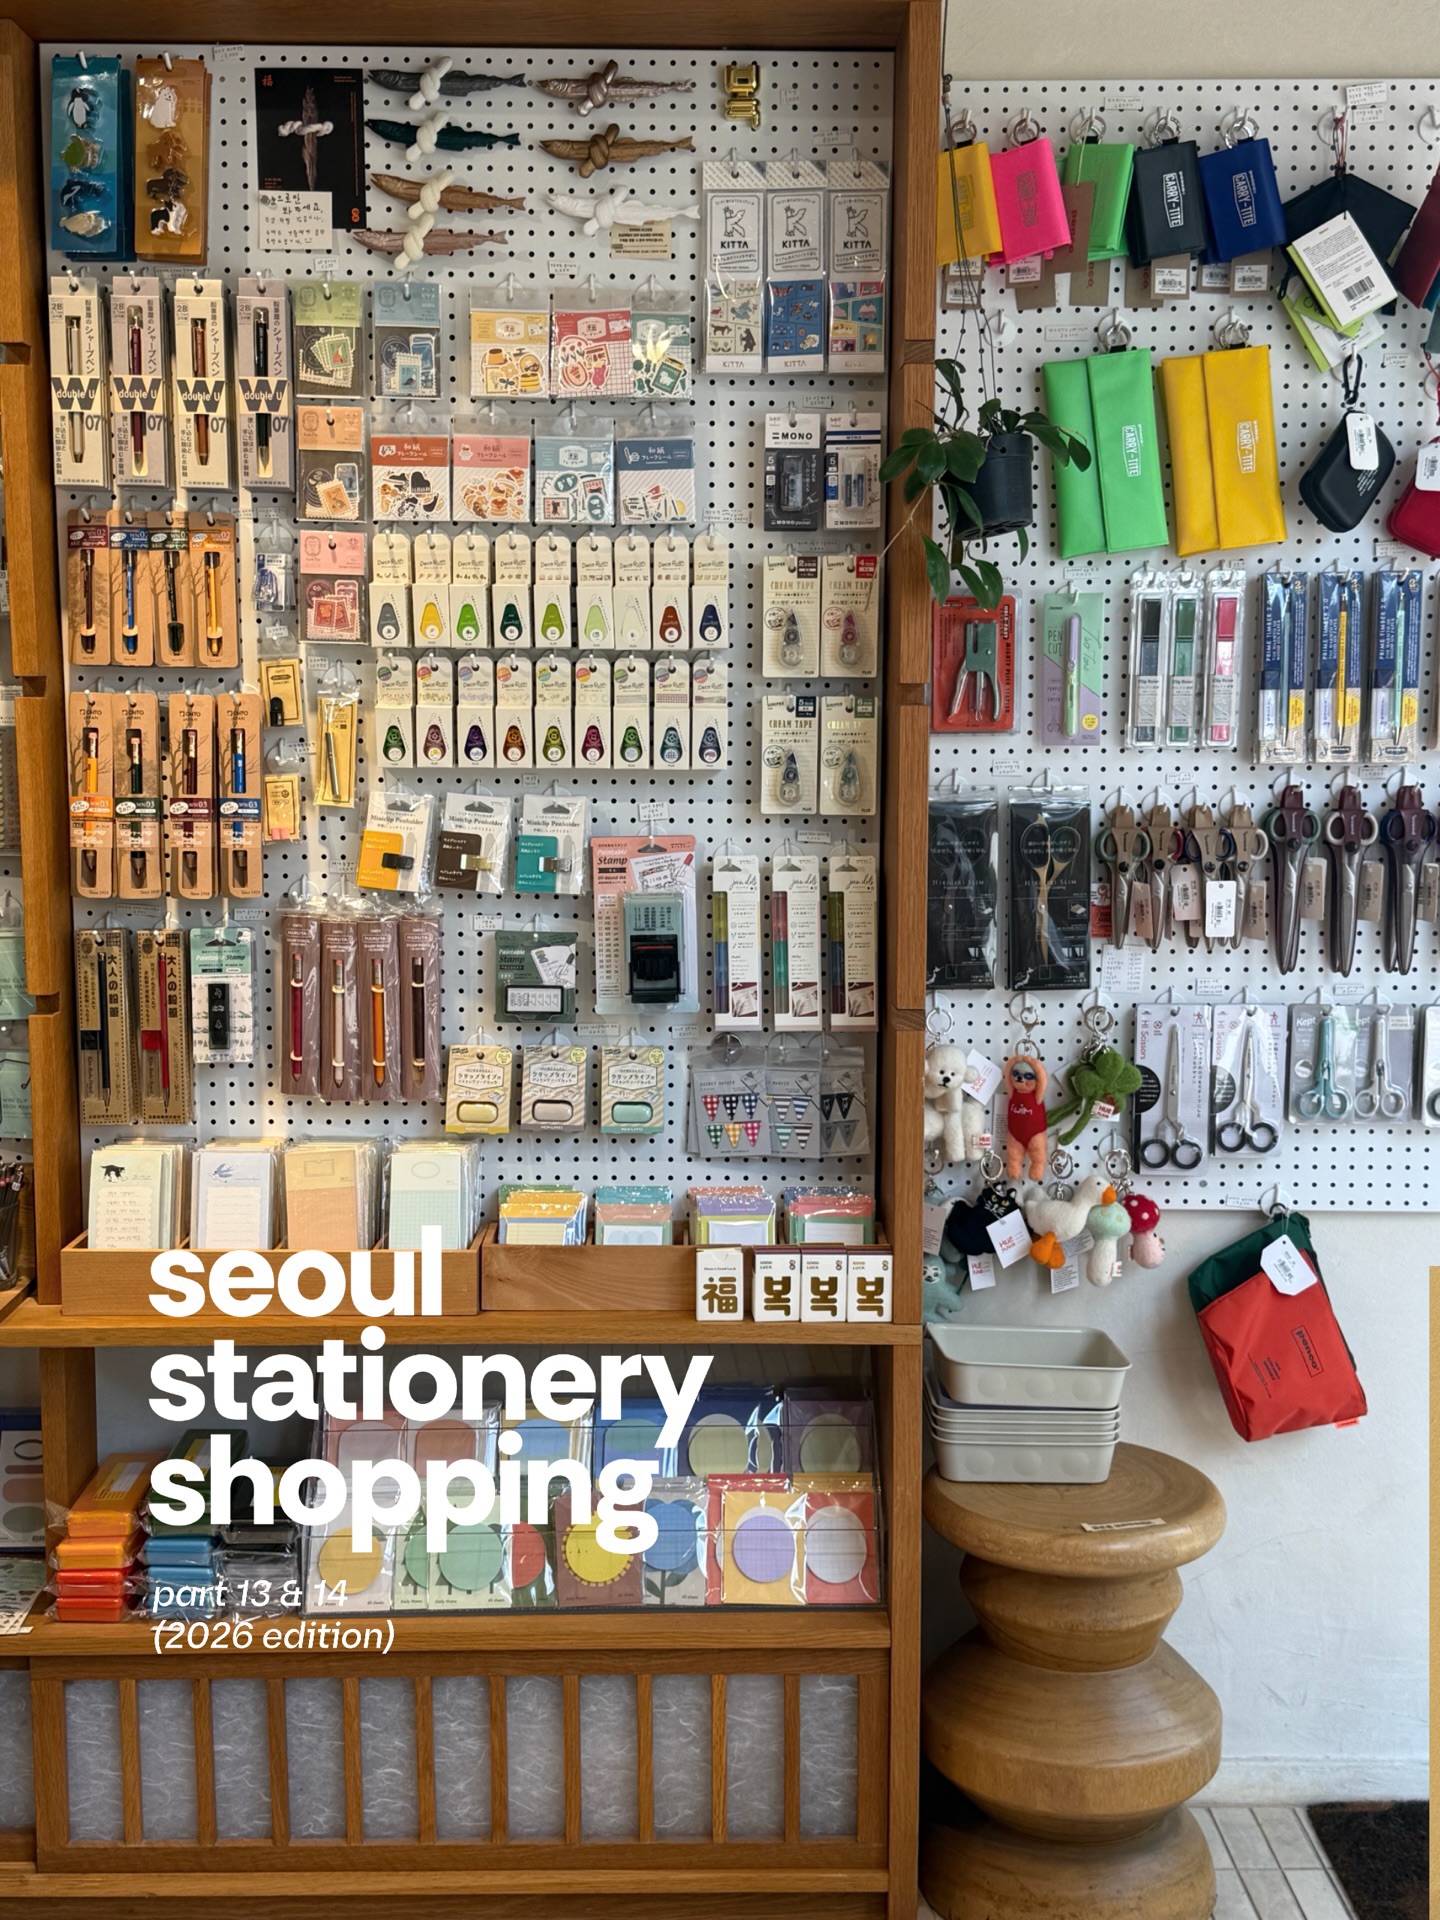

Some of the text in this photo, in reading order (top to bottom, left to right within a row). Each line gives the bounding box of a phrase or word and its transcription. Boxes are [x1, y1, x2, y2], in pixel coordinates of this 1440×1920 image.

[1165, 173, 1181, 226] CARRY-TITE
[1235, 173, 1253, 226] CARRY-TITE
[720, 240, 749, 249] KITTA
[782, 239, 810, 248] KITTA
[843, 240, 872, 249] KITTA
[56, 389, 96, 399] double U
[118, 389, 157, 400] double U
[182, 391, 221, 401] double U
[244, 391, 283, 401] double U
[85, 415, 101, 431] 07
[147, 415, 163, 431] 07
[210, 417, 226, 434] 07
[272, 416, 289, 433] 07
[781, 432, 813, 440] MONO
[1125, 425, 1139, 476] CARRY-TITE
[1240, 422, 1253, 472] CARRY-TITE
[770, 581, 815, 590] CREAM TAPE
[829, 581, 852, 590] CREAM
[1048, 630, 1063, 641] PEN
[1048, 643, 1063, 656] CUT
[769, 720, 813, 729] CREAM TAPE
[370, 815, 424, 826] Miniclip Penholder
[449, 816, 504, 826] Miniclip Penholder
[526, 819, 580, 828] Miniclip Penholder
[597, 856, 628, 866] Stamp
[108, 954, 119, 1018] 大人の鉛筆
[167, 955, 178, 1018] 大人の鉛筆
[1296, 1016, 1316, 1027] Kept
[1140, 1031, 1149, 1060] Scissors
[702, 1277, 738, 1314] 福
[764, 1276, 791, 1316] 복
[811, 1276, 838, 1316] 복
[857, 1276, 884, 1317] 복
[1296, 1330, 1317, 1369] penco
